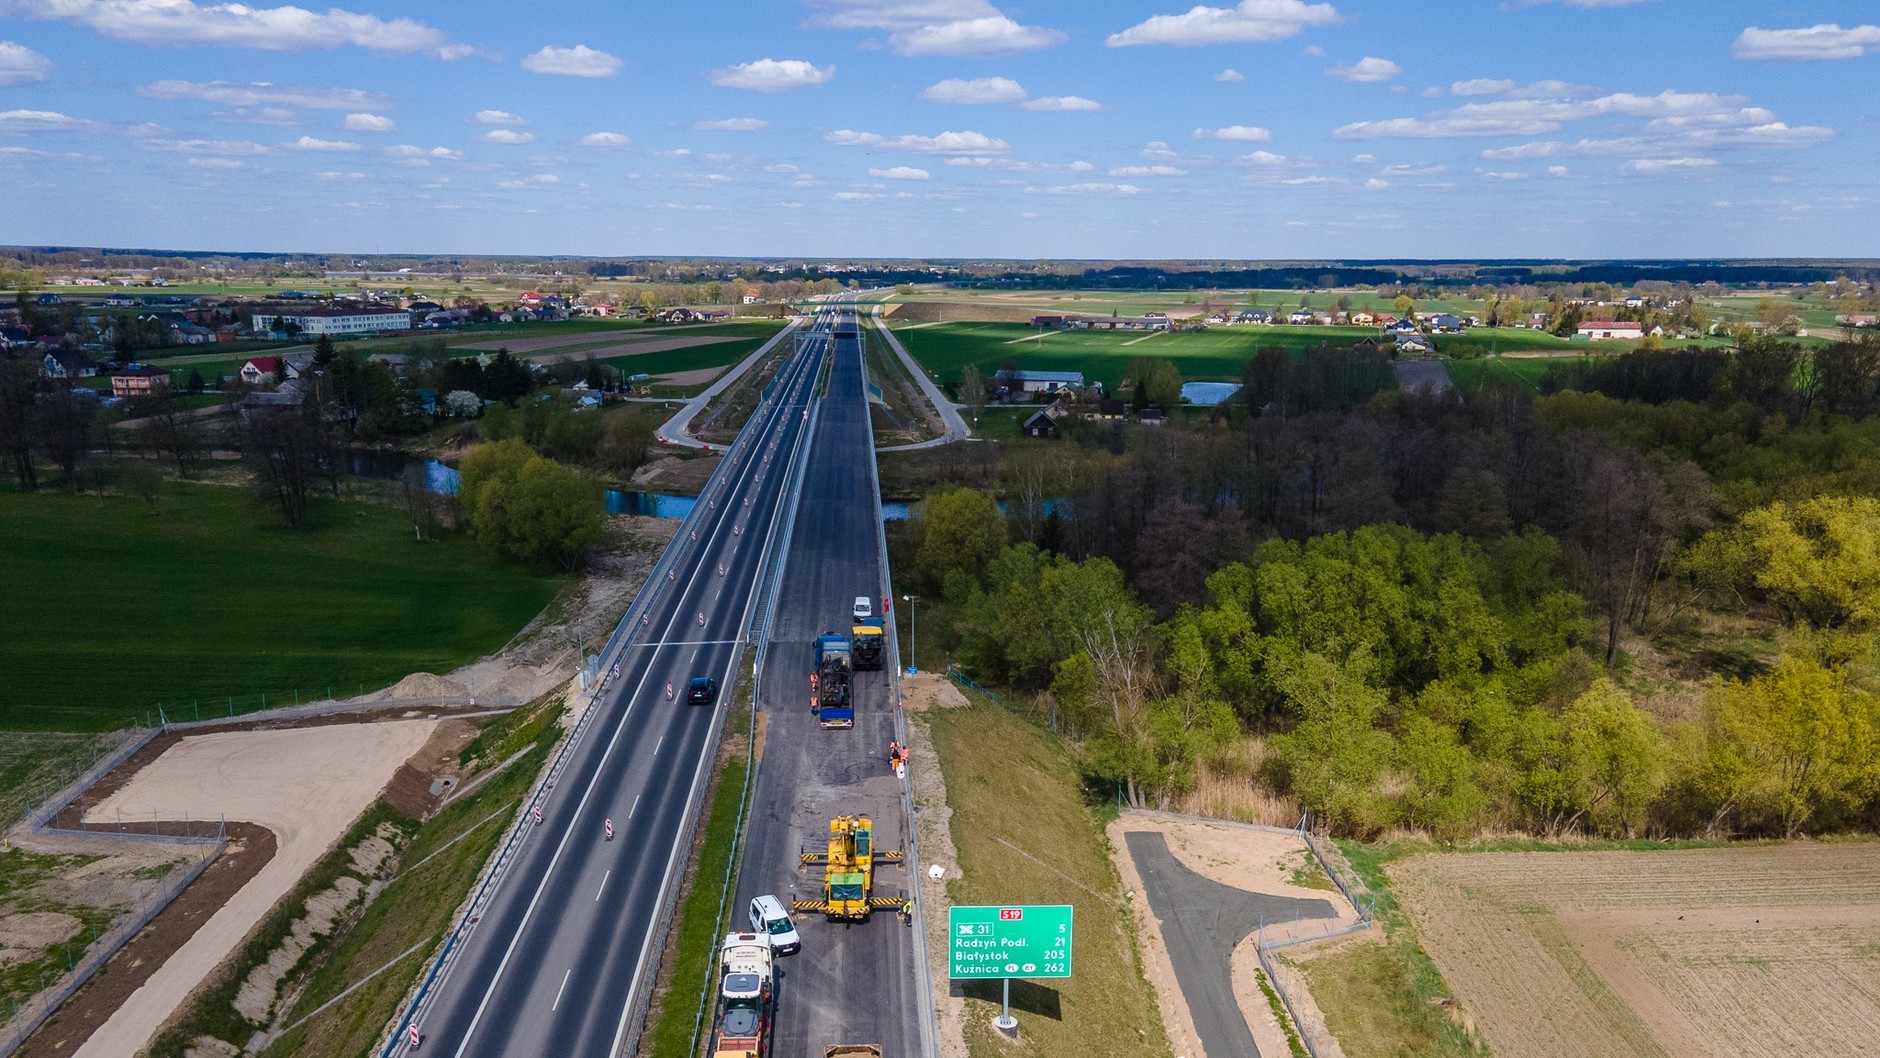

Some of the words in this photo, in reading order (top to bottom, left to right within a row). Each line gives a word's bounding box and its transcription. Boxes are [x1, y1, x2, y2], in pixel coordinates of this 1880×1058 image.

[978, 925, 989, 934] 31
[1059, 924, 1065, 932] 5
[956, 938, 996, 949] Radzyń
[1001, 938, 1028, 946] Podl.
[1055, 938, 1065, 946] 21
[956, 952, 1008, 962] Białystok
[1044, 951, 1064, 959] 205
[956, 964, 999, 973] Kuźnica
